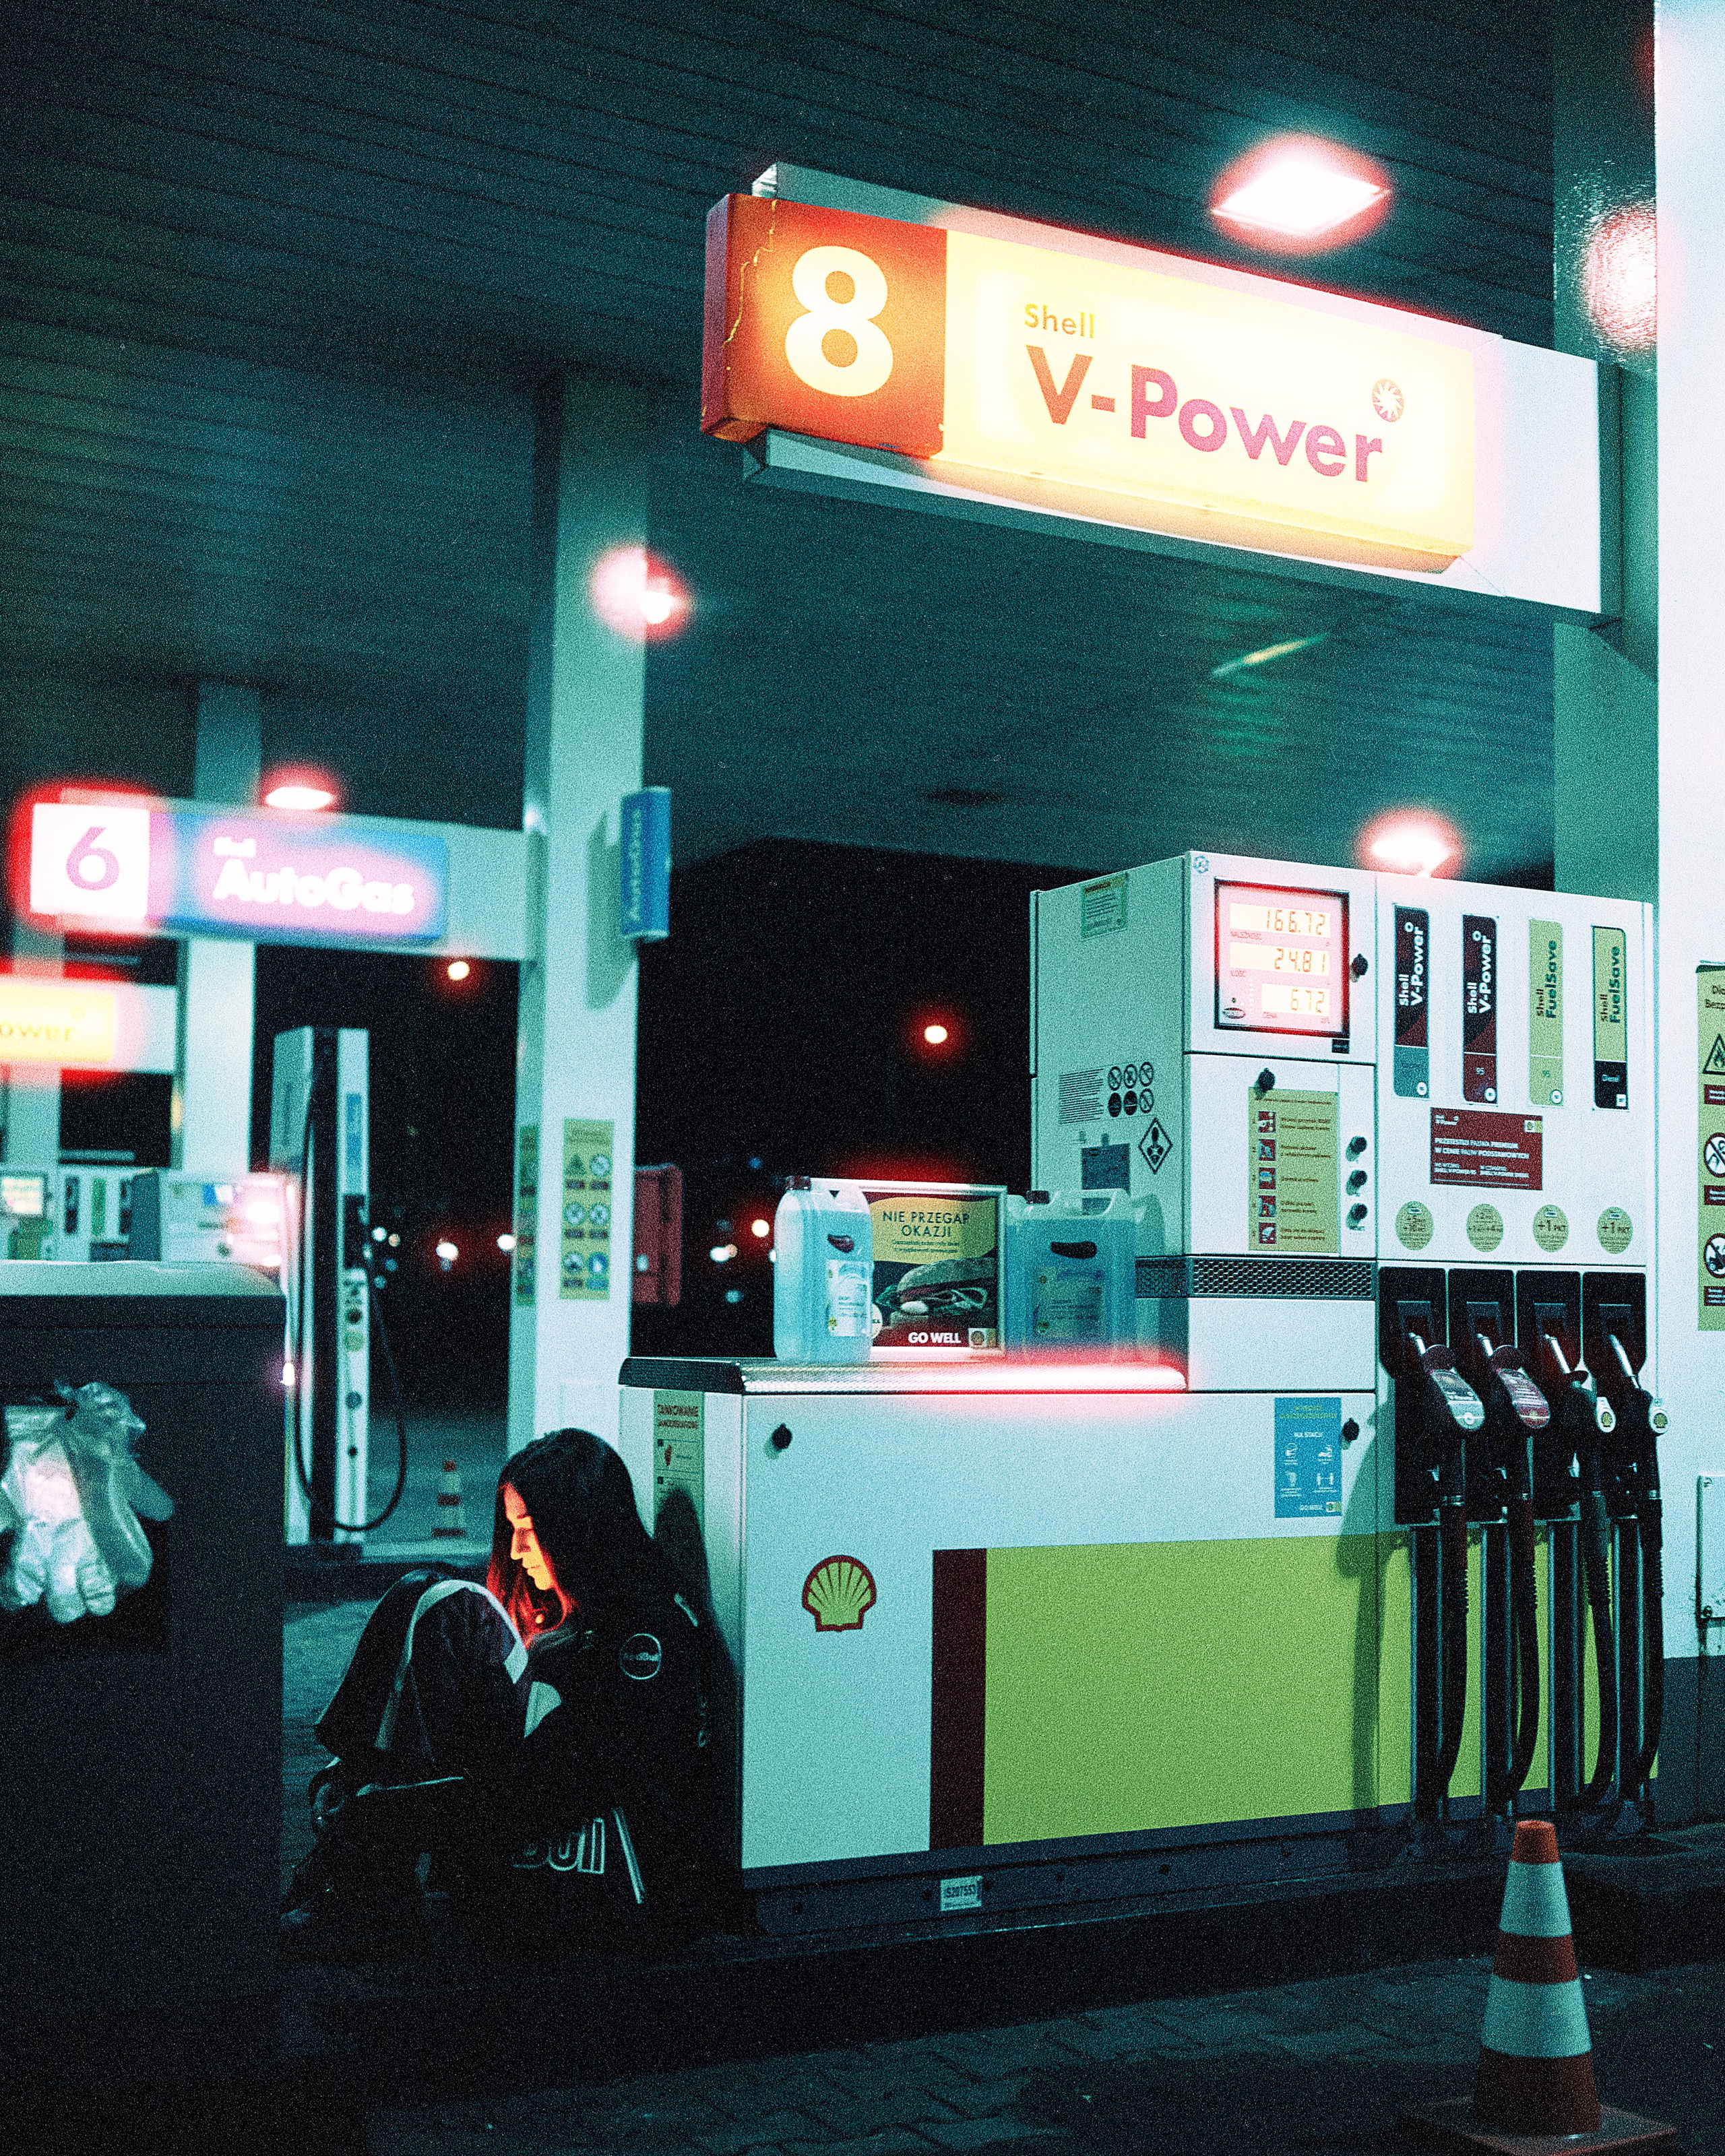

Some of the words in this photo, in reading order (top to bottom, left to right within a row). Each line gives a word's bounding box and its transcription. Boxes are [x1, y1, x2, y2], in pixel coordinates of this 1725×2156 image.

[784, 245, 895, 398] 8
[1024, 303, 1096, 340] Shell
[1025, 344, 1383, 484] V-Power
[66, 826, 120, 891] 6
[212, 858, 415, 915] AutoGas
[1265, 908, 1326, 936] 166.72
[1274, 947, 1326, 974] 24.81
[1410, 926, 1425, 1006] V-Power
[1478, 934, 1492, 1014] V-Power
[1398, 974, 1410, 1007] Shell
[1545, 939, 1557, 1019] FuelSave
[1610, 945, 1621, 1023] FuelSave
[1290, 988, 1325, 1014] 6.72
[1466, 982, 1478, 1014] Shell
[1536, 988, 1544, 1018] Shell
[1600, 993, 1608, 1023] Shell
[882, 1211, 906, 1223] NIE
[911, 1211, 970, 1225] PRZEGAP
[901, 1224, 951, 1238] OKAZJI
[908, 1331, 929, 1343] GO
[930, 1333, 961, 1344] WELL
